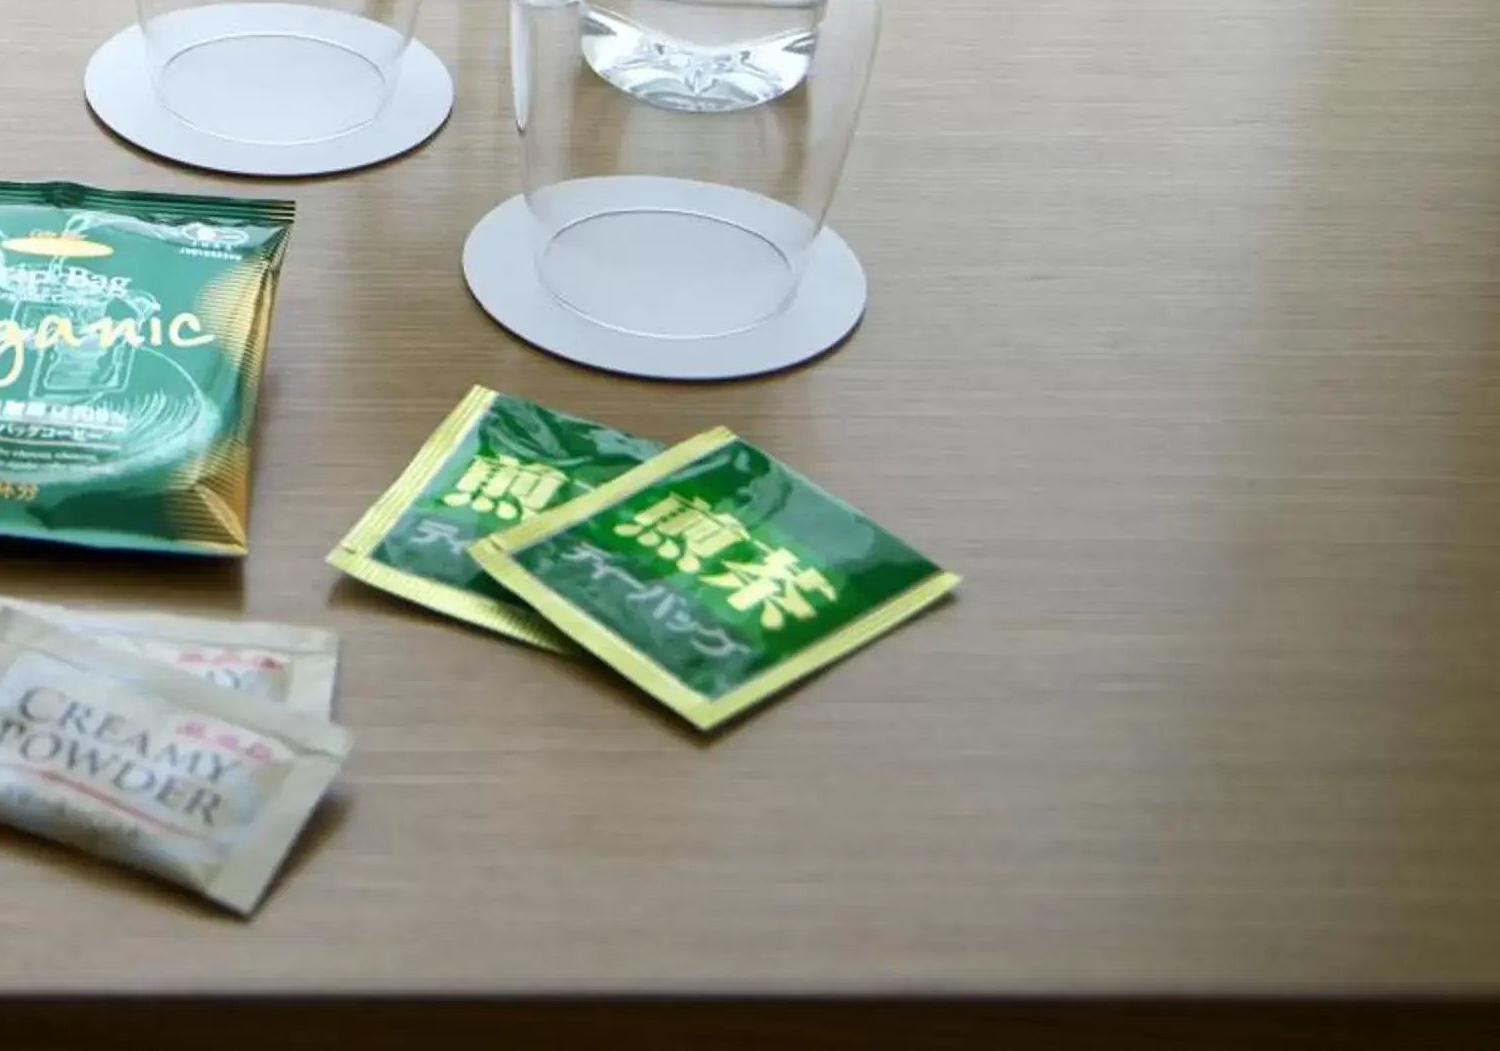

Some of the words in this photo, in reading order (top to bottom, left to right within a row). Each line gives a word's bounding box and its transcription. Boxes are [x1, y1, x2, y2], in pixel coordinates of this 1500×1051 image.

[61, 265, 133, 299] Bag
[612, 490, 838, 630] 煎茶
[17, 685, 243, 785] CREAMY
